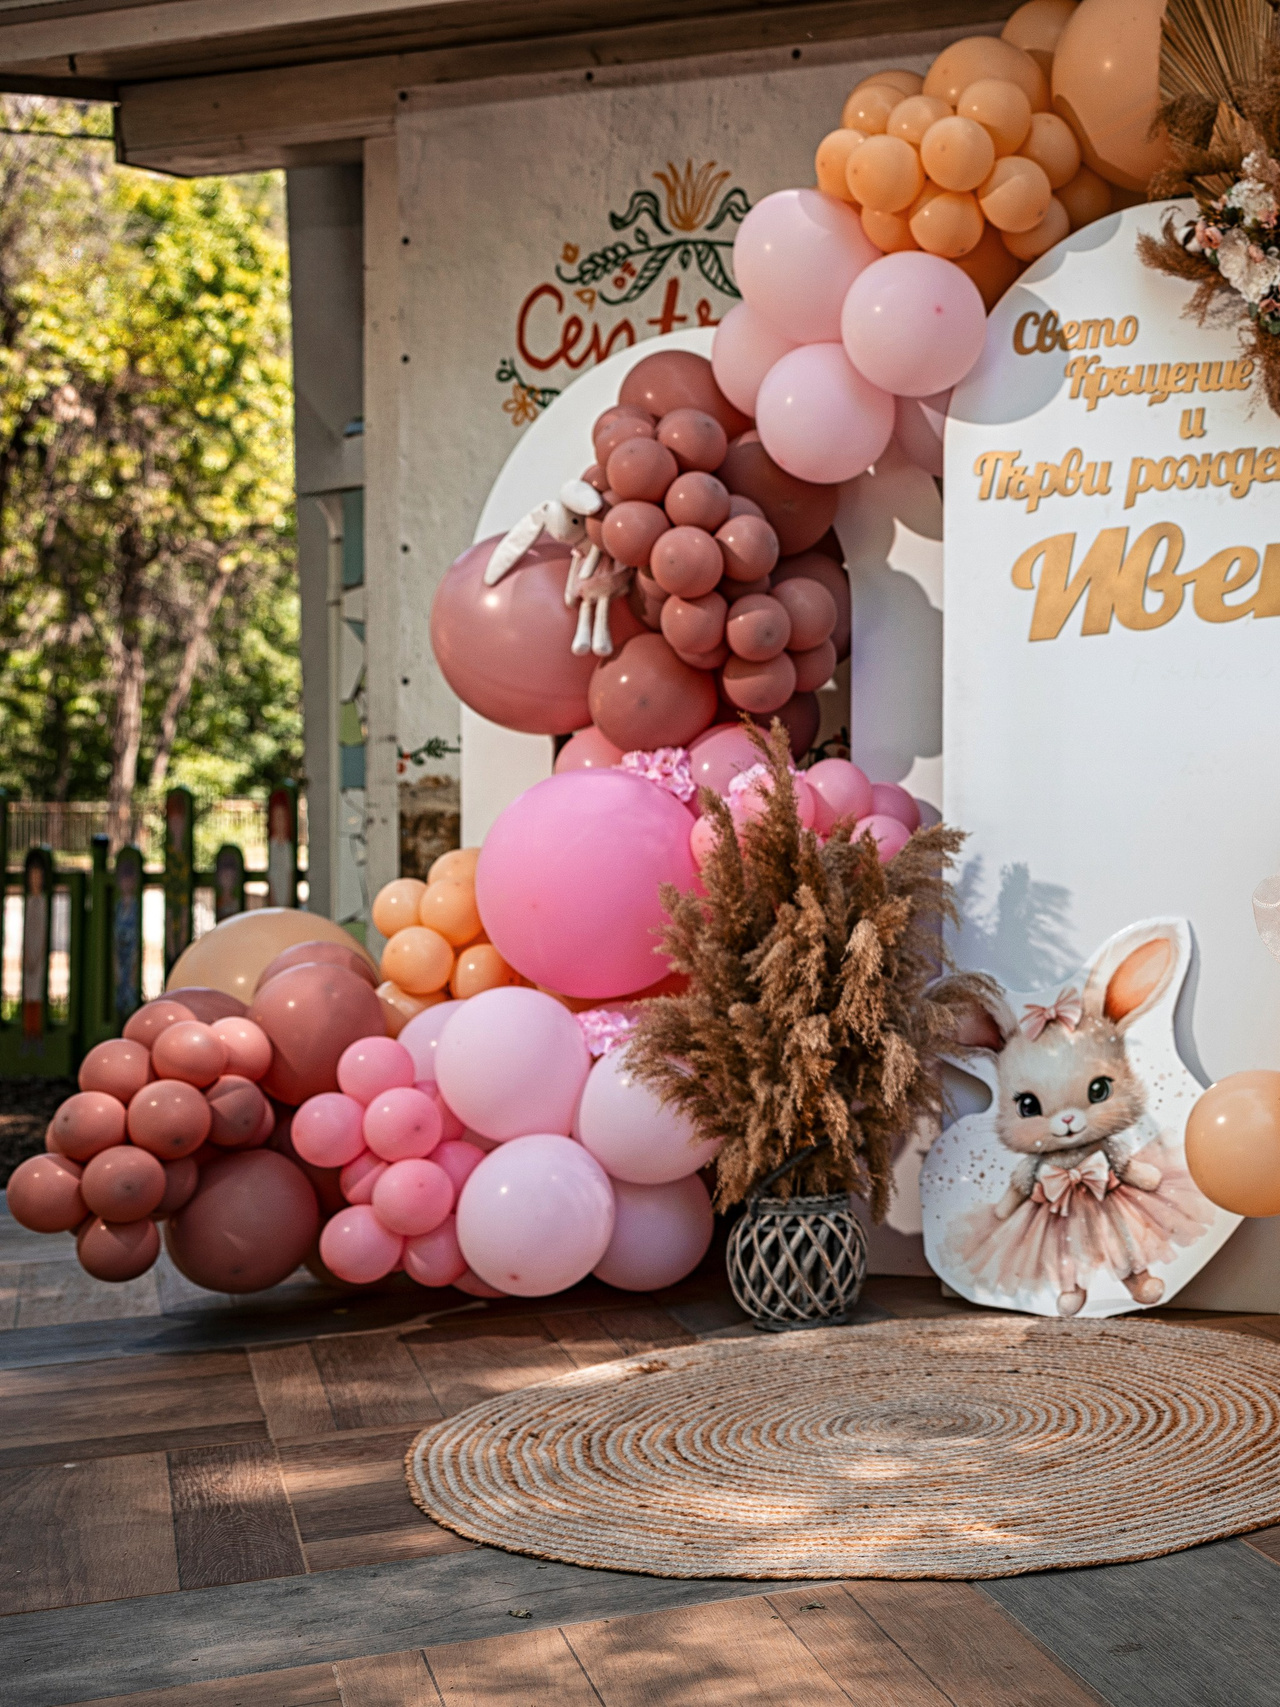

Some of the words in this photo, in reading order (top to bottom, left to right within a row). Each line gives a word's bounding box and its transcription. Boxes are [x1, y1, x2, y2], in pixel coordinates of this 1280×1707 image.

[1013, 310, 1139, 356] Свето
[1064, 355, 1255, 411] Кръщение
[1178, 407, 1206, 440] и
[973, 447, 1113, 514] Първи
